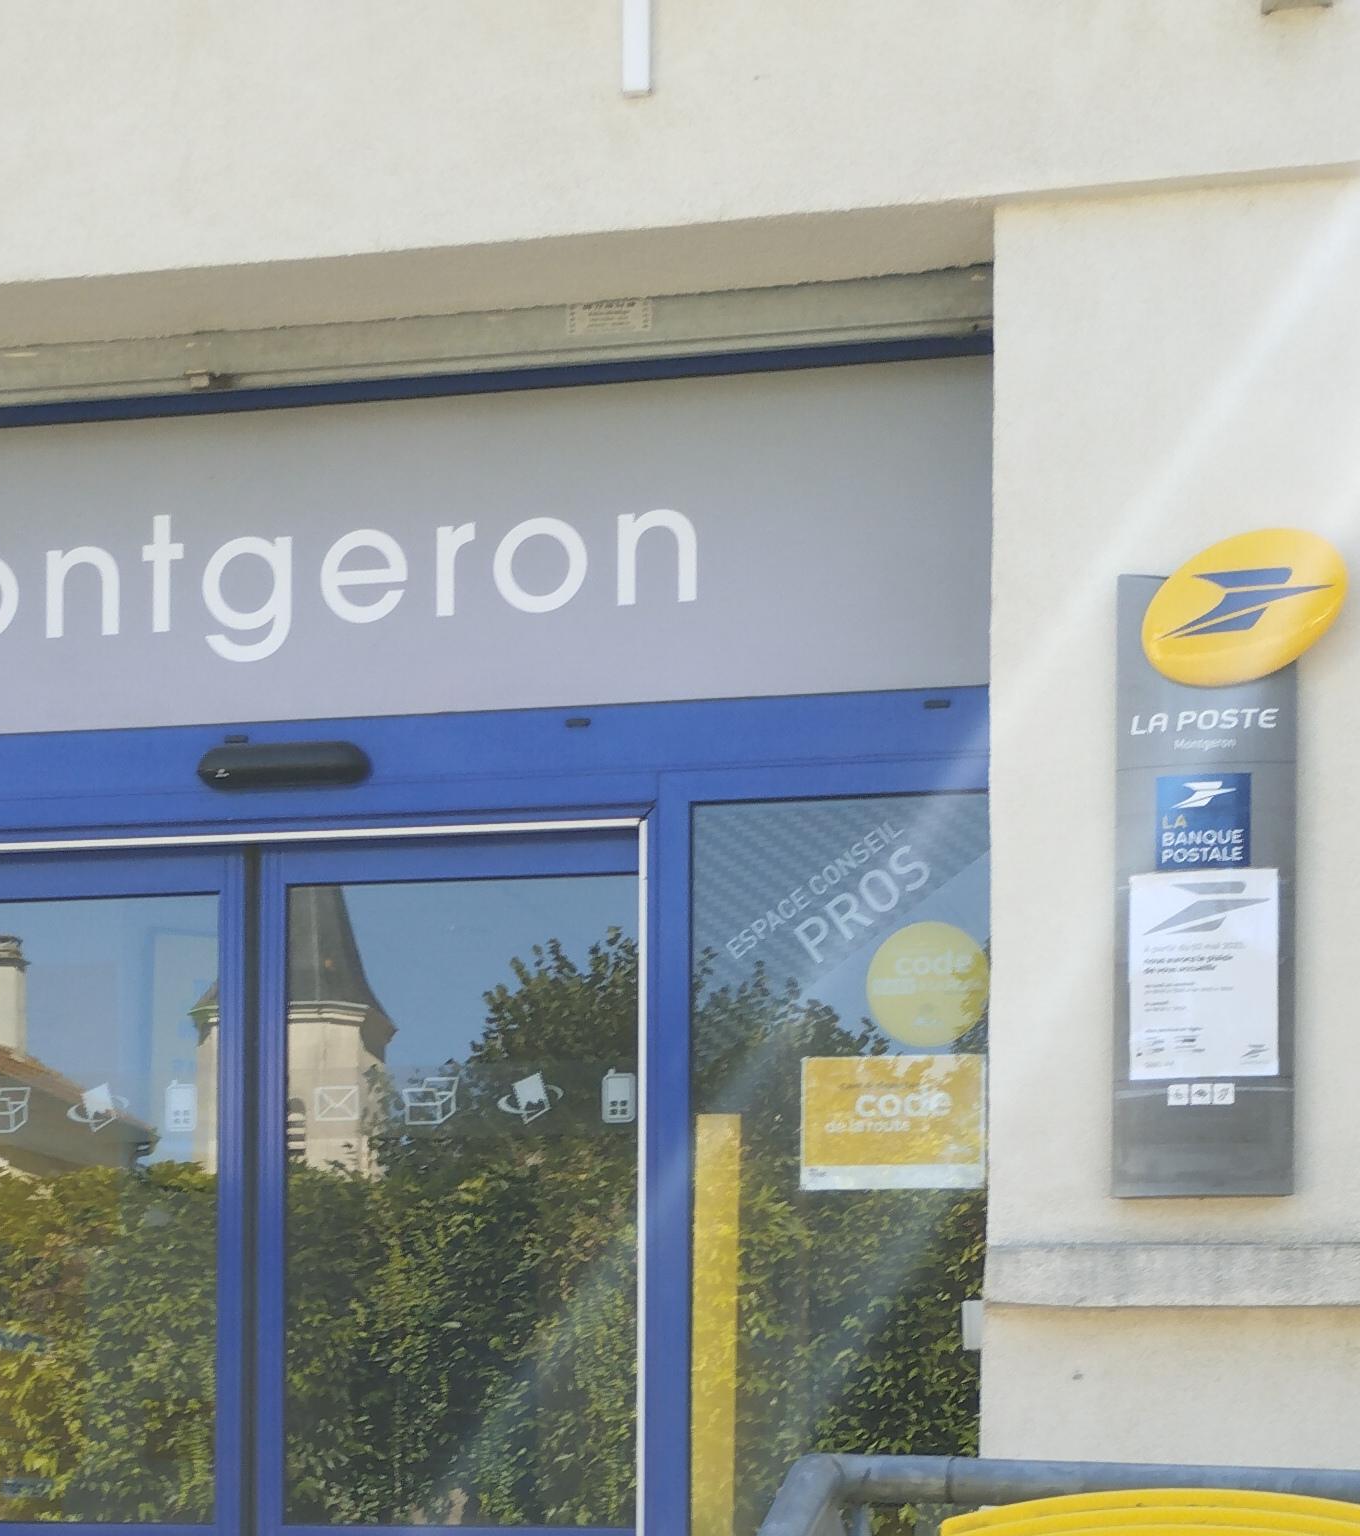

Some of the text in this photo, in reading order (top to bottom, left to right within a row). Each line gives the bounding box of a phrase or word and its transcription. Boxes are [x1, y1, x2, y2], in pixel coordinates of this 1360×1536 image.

[1129, 707, 1279, 736] LA POSTE
[1173, 736, 1237, 751] Montgeron
[1161, 814, 1187, 830] LA
[1161, 828, 1244, 848] BANQUE
[1161, 846, 1243, 864] POSTALE
[725, 821, 905, 960] ESPACE CONSEIL
[792, 844, 931, 965] PROS
[854, 1086, 953, 1118] code
